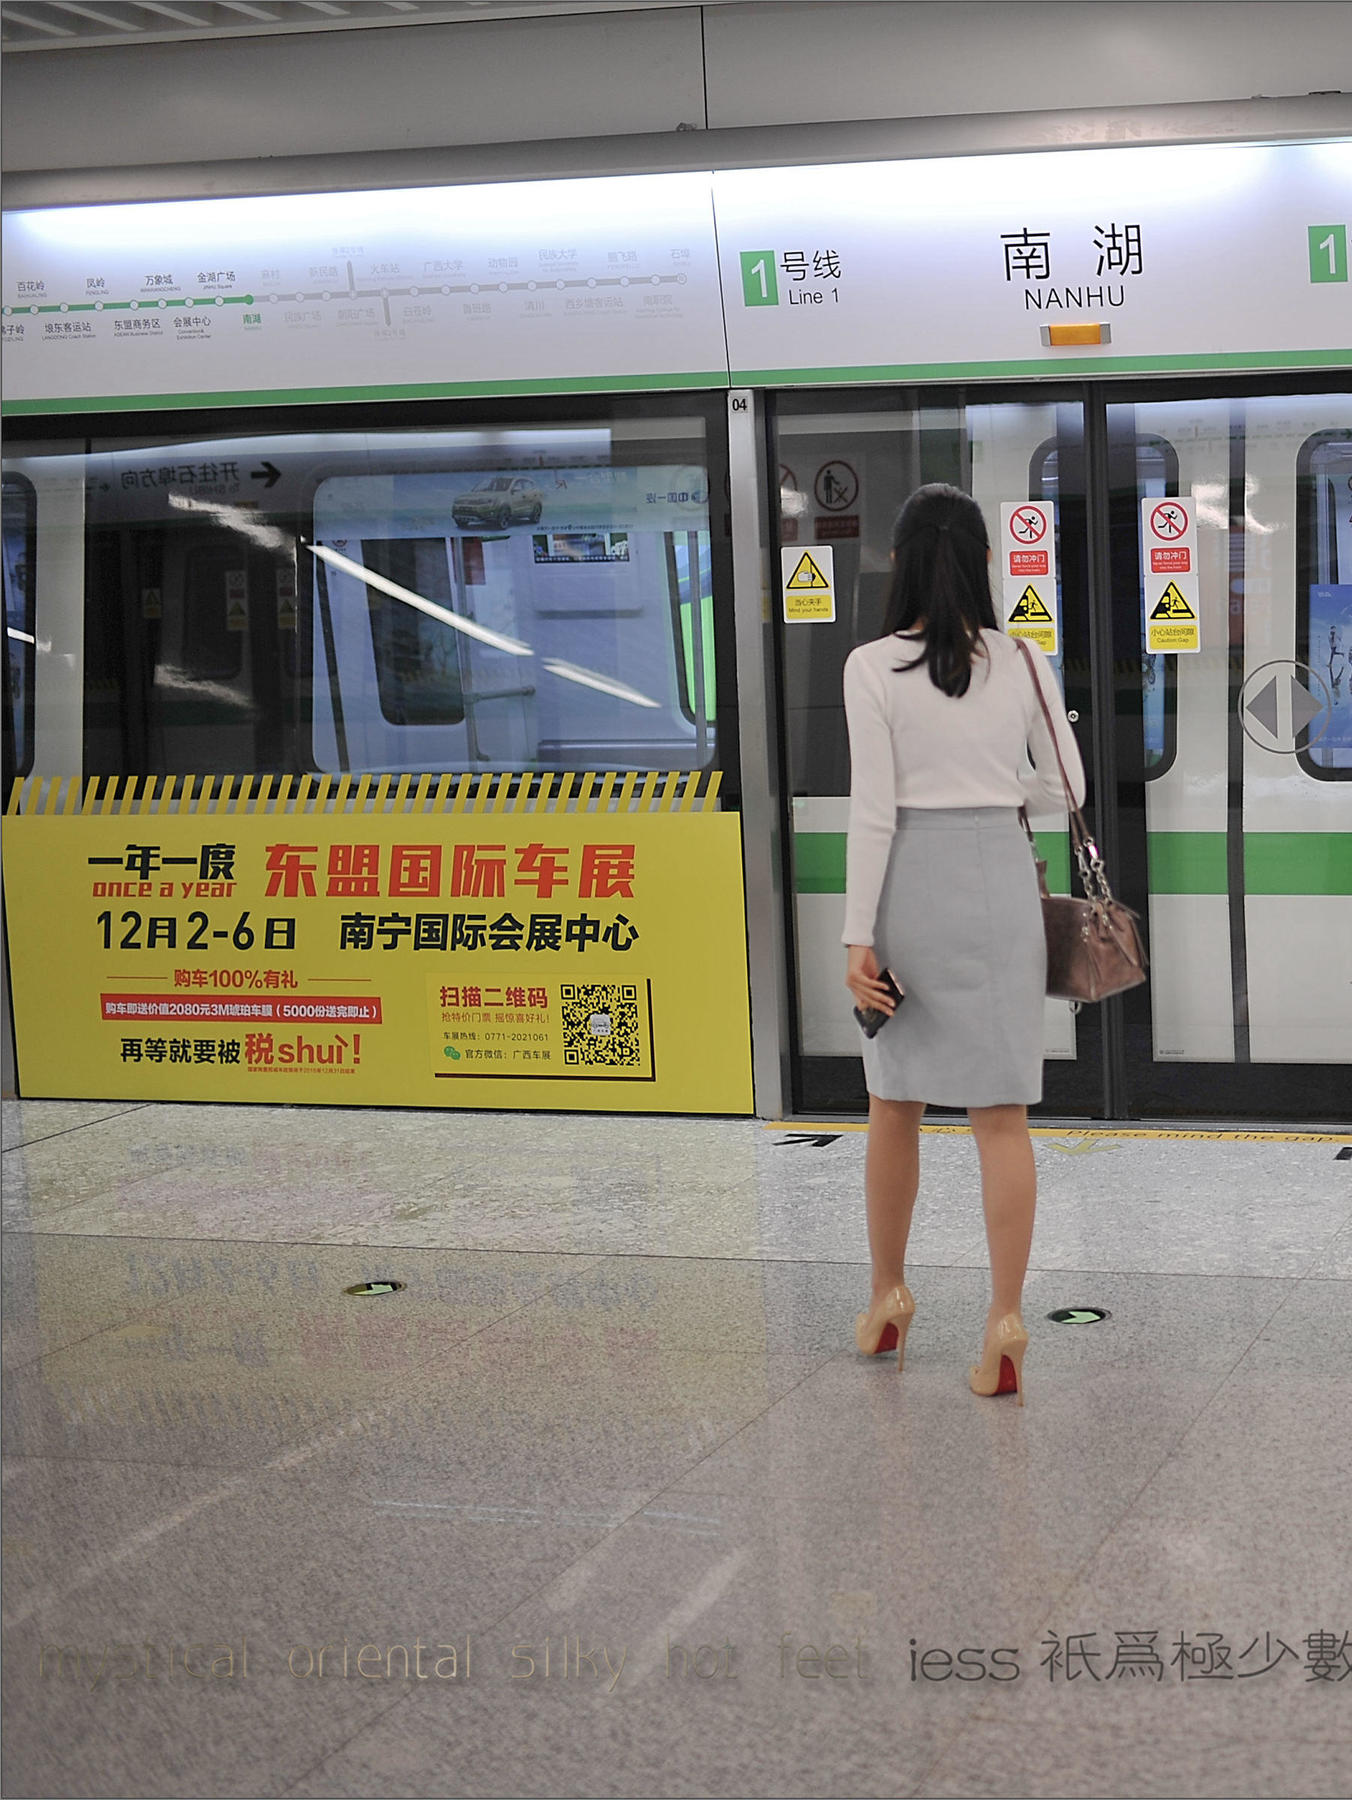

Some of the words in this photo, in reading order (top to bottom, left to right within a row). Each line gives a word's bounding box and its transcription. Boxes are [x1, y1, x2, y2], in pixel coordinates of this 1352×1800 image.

[1000, 224, 1143, 280] 南湖
[145, 274, 173, 286] 万象城
[197, 271, 236, 283] 金湖广场
[17, 280, 45, 292] 百花岭
[788, 288, 824, 305] Line
[832, 287, 839, 303] 1
[1024, 285, 1125, 311] NANHU
[114, 319, 161, 331] 东盟商务区
[173, 316, 211, 328] 会展中心
[732, 398, 748, 411] 04
[1013, 554, 1045, 563] 请勿冲门
[1154, 551, 1187, 560] 请勿冲门
[88, 843, 236, 880] 一年一度
[264, 843, 636, 898] 东盟国际车展
[92, 881, 152, 897] once
[160, 882, 173, 897] a
[181, 882, 237, 899] year
[97, 911, 296, 950] 12月2-6日
[340, 912, 639, 952] 南宁国际会展中心
[174, 969, 298, 989] 购车100%有礼
[440, 986, 548, 1009] 扫描二维码
[441, 1012, 491, 1023] 抢特价门票
[1066, 1129, 1147, 1138] Please
[1158, 1132, 1223, 1140] mind
[1233, 1133, 1275, 1141] the
